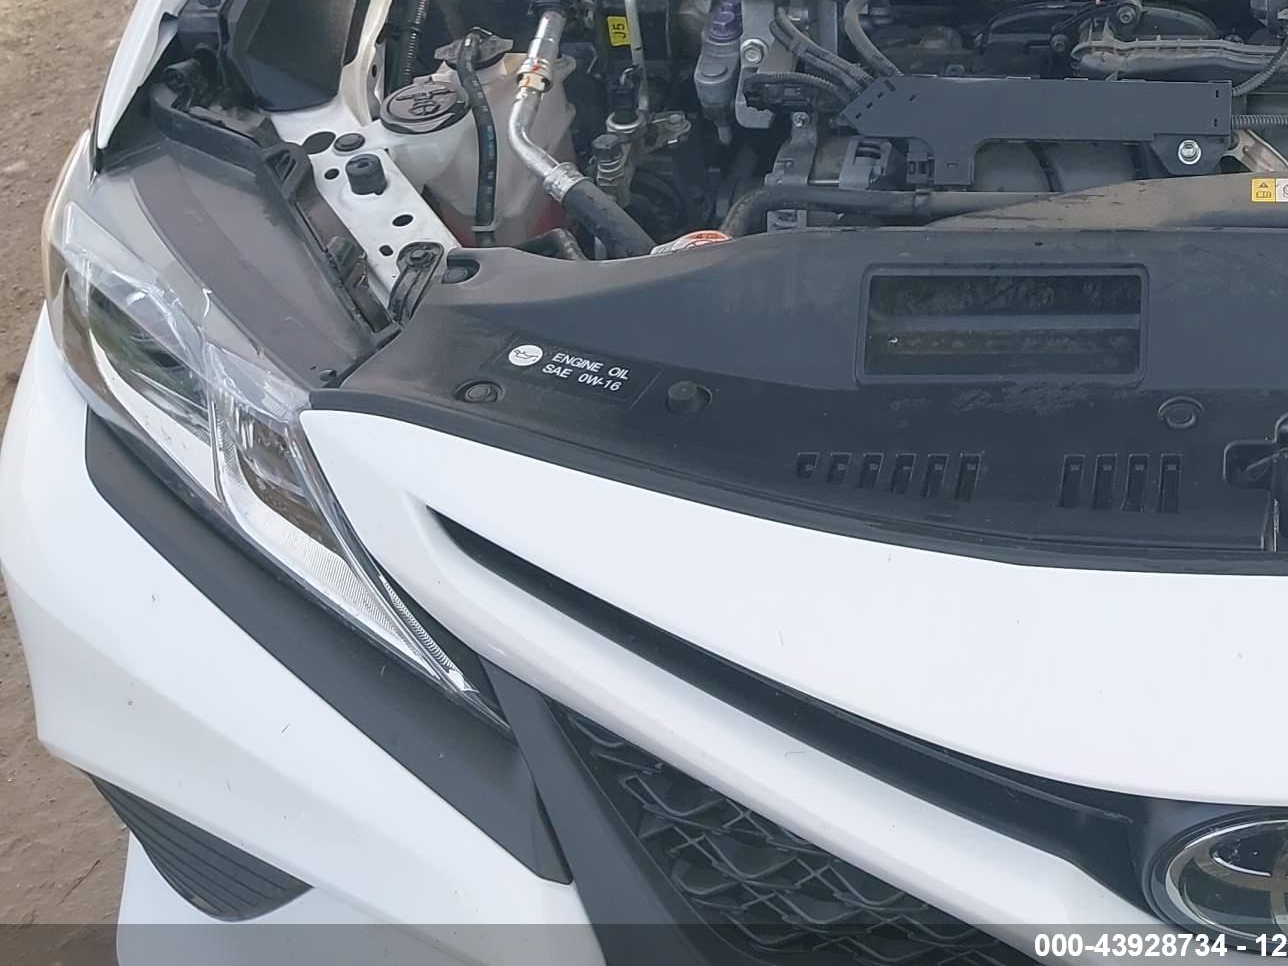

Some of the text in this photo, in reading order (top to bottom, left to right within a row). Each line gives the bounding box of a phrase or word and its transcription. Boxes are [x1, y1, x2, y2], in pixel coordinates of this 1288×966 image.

[612, 23, 627, 38] J5
[542, 363, 622, 391] SAE 0W-16
[552, 353, 630, 380] ENGINE OIL
